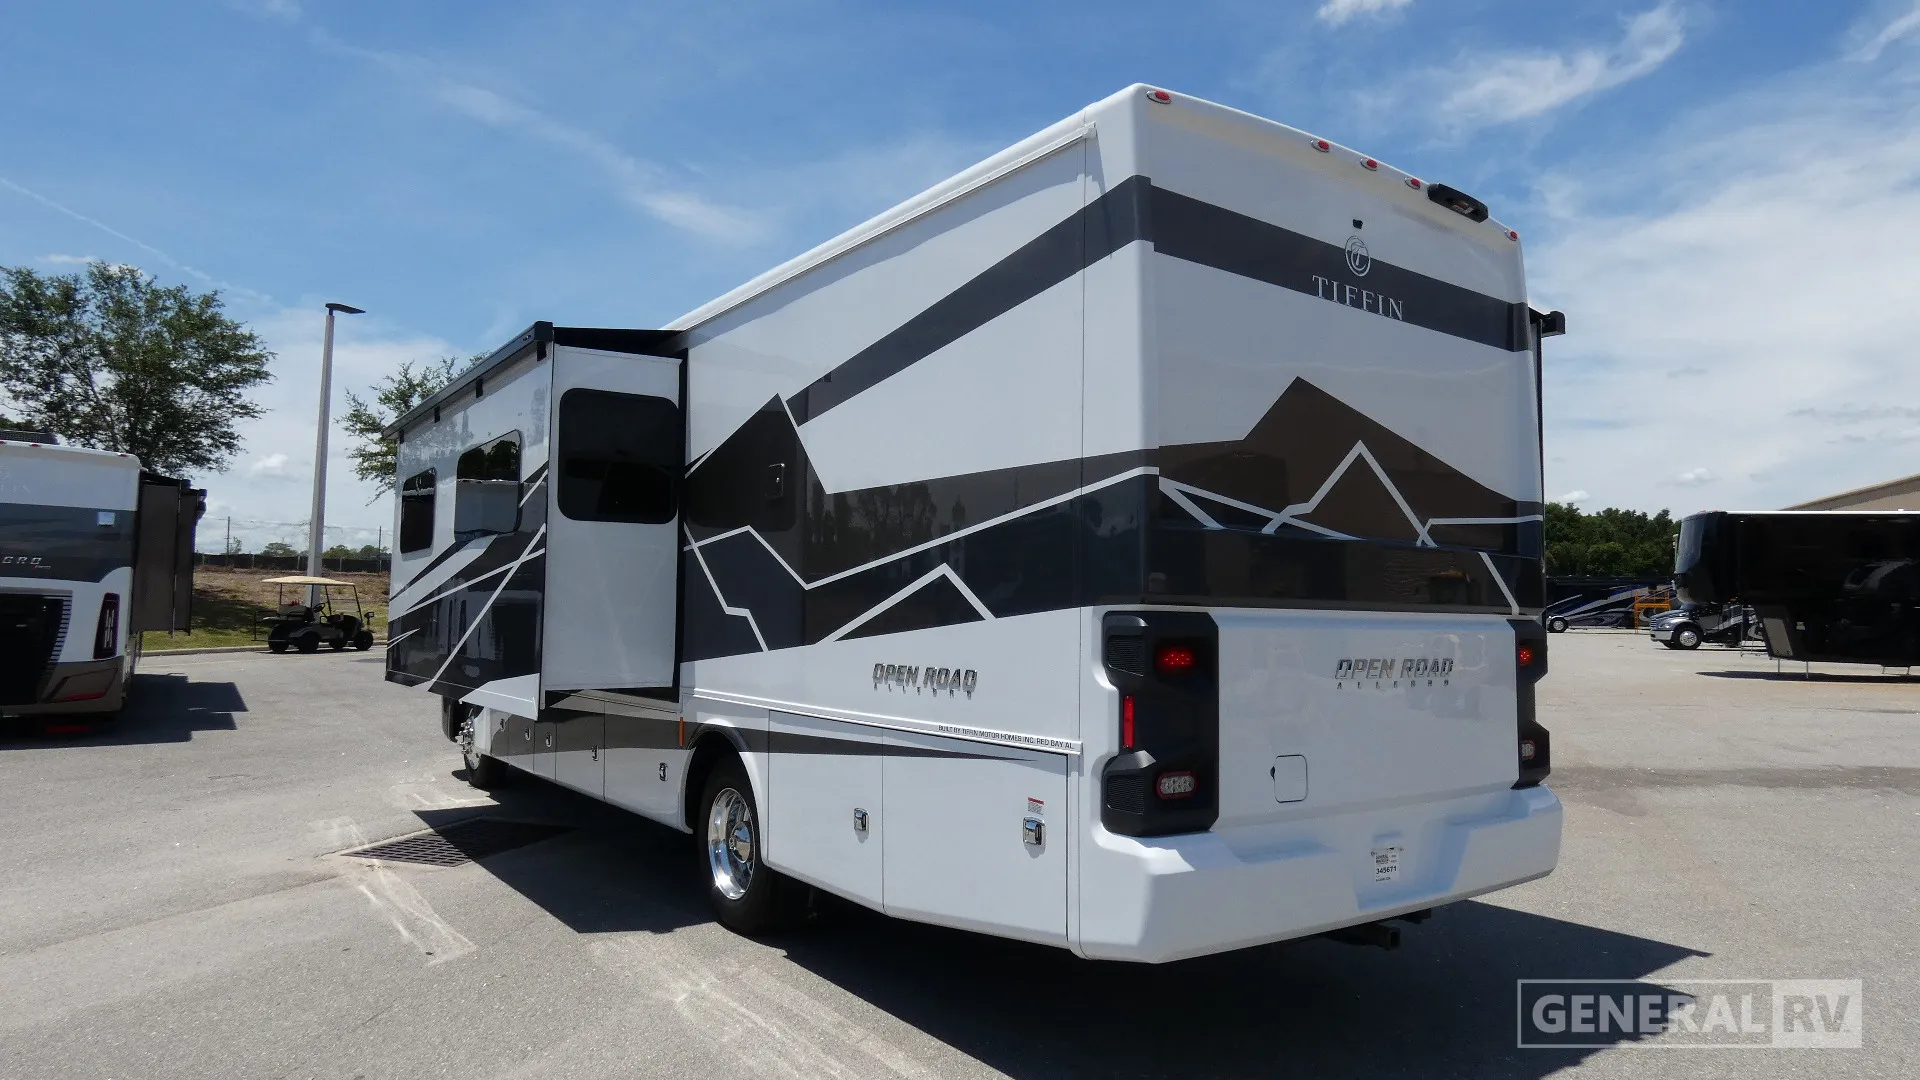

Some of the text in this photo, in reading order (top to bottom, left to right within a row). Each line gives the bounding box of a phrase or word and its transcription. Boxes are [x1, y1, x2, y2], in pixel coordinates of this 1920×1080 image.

[1312, 274, 1403, 321] TIFFIN
[872, 662, 978, 693] OPEN ROAD
[1335, 657, 1454, 680] OPEN ROAD
[978, 729, 1000, 739] MOTOR
[1000, 733, 1022, 742] HOMES
[1036, 737, 1050, 746] RED
[1375, 865, 1397, 875] 345671
